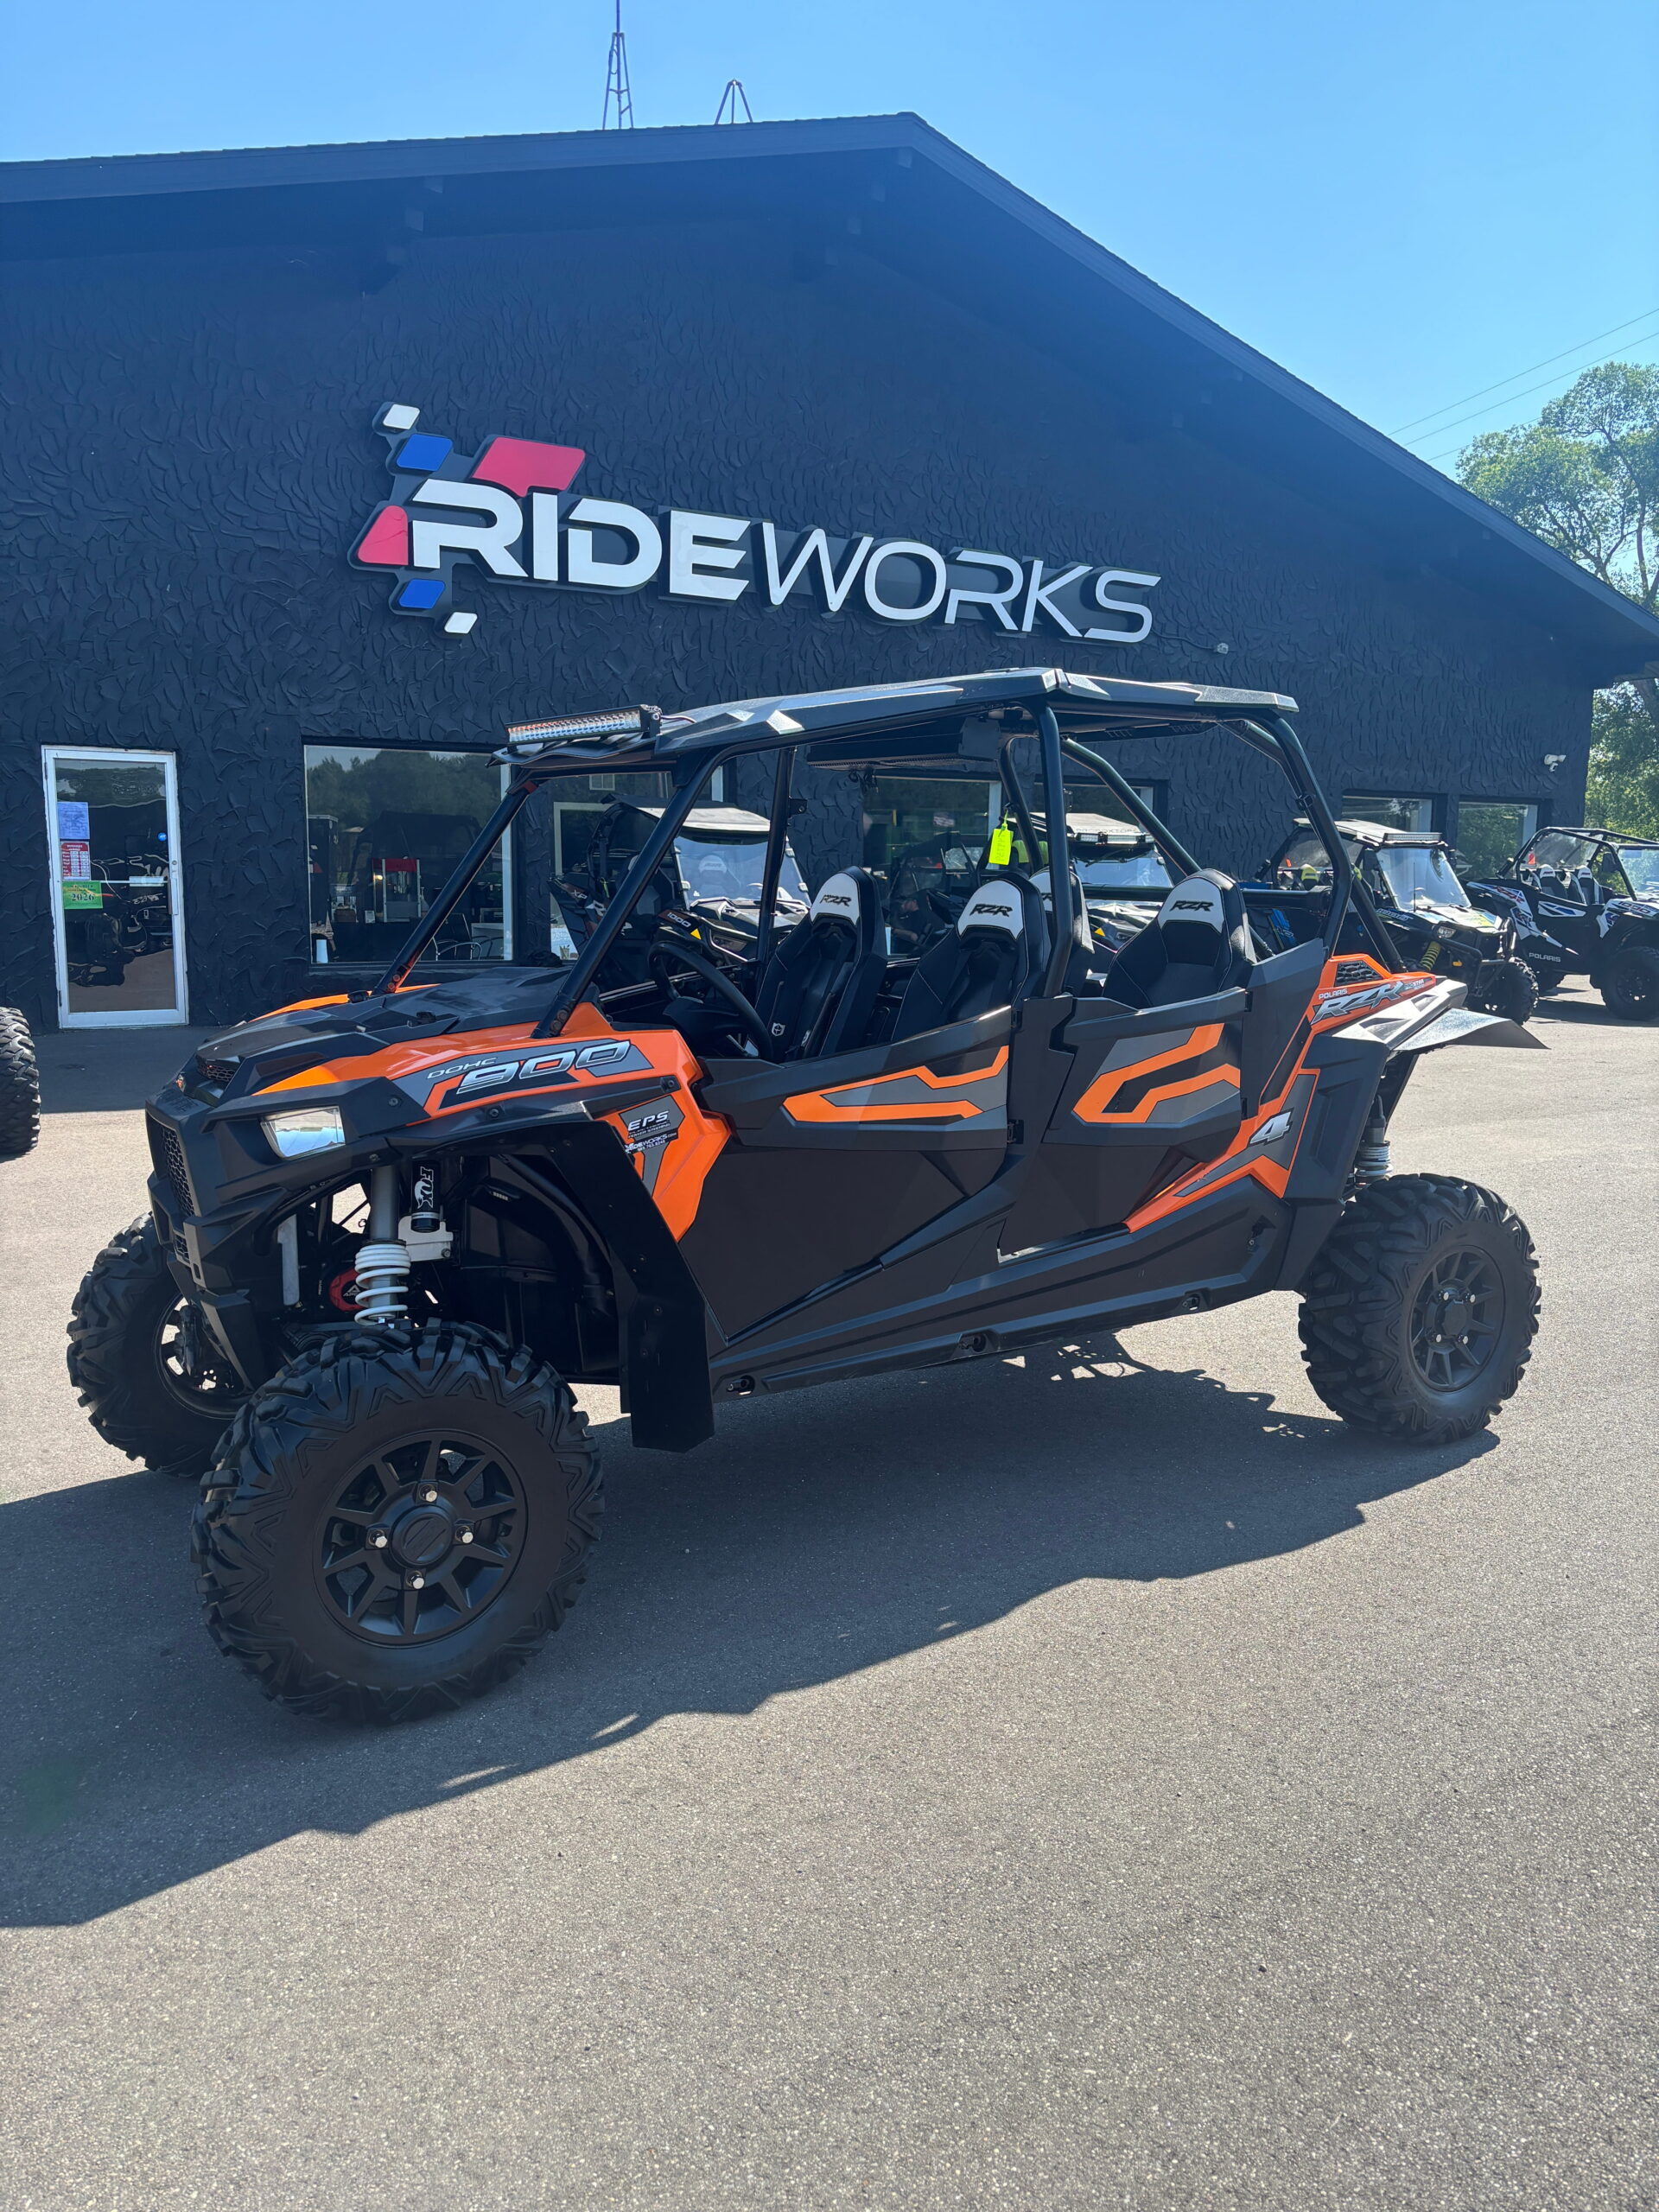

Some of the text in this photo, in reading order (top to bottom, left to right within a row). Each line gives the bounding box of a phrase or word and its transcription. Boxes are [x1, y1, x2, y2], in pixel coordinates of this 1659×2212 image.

[412, 478, 1161, 643] RIDEWORKS
[819, 894, 852, 907] RZR
[969, 903, 1013, 918] RZR
[1169, 900, 1214, 912] RZR
[1529, 952, 1561, 963] POLARIS
[1310, 981, 1404, 1026] RZR
[1319, 988, 1348, 1000] POLARIS
[427, 1057, 498, 1079] DOHC
[455, 1039, 632, 1096] 900
[628, 1110, 670, 1131] EPS
[1249, 1110, 1292, 1145] 4
